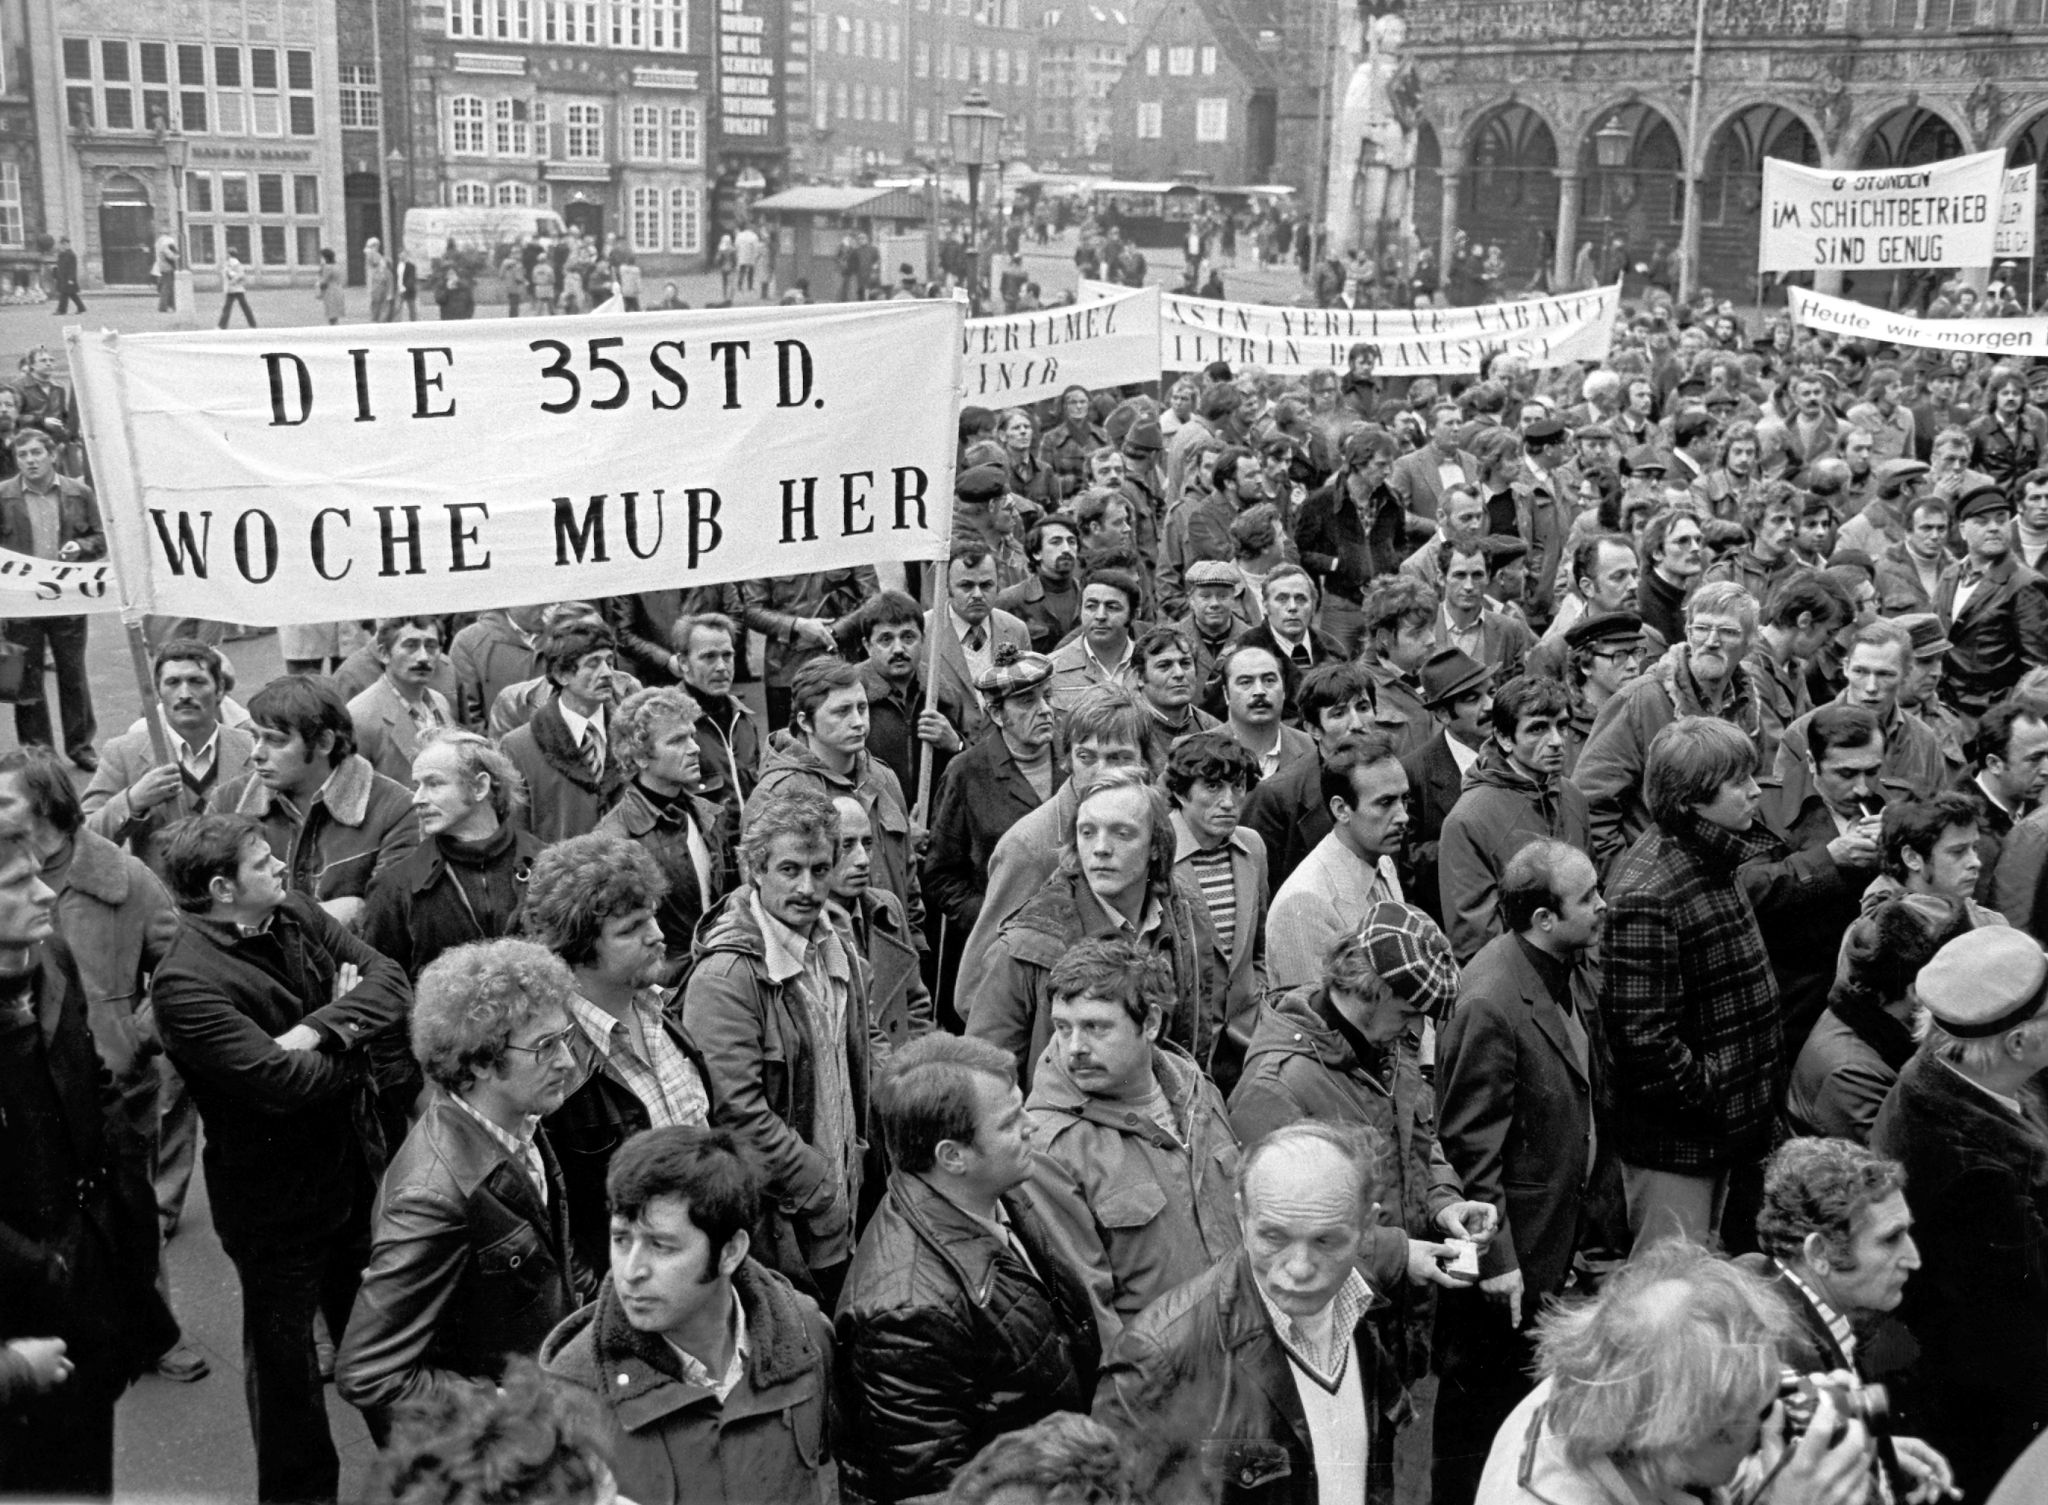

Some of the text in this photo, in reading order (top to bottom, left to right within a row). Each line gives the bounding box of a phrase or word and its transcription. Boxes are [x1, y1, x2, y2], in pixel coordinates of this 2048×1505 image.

[1879, 234, 1943, 263] GENUG
[1801, 299, 1870, 330] Heute
[261, 348, 457, 427] DIE
[149, 502, 491, 584] WOCHE
[778, 466, 929, 545] HER
